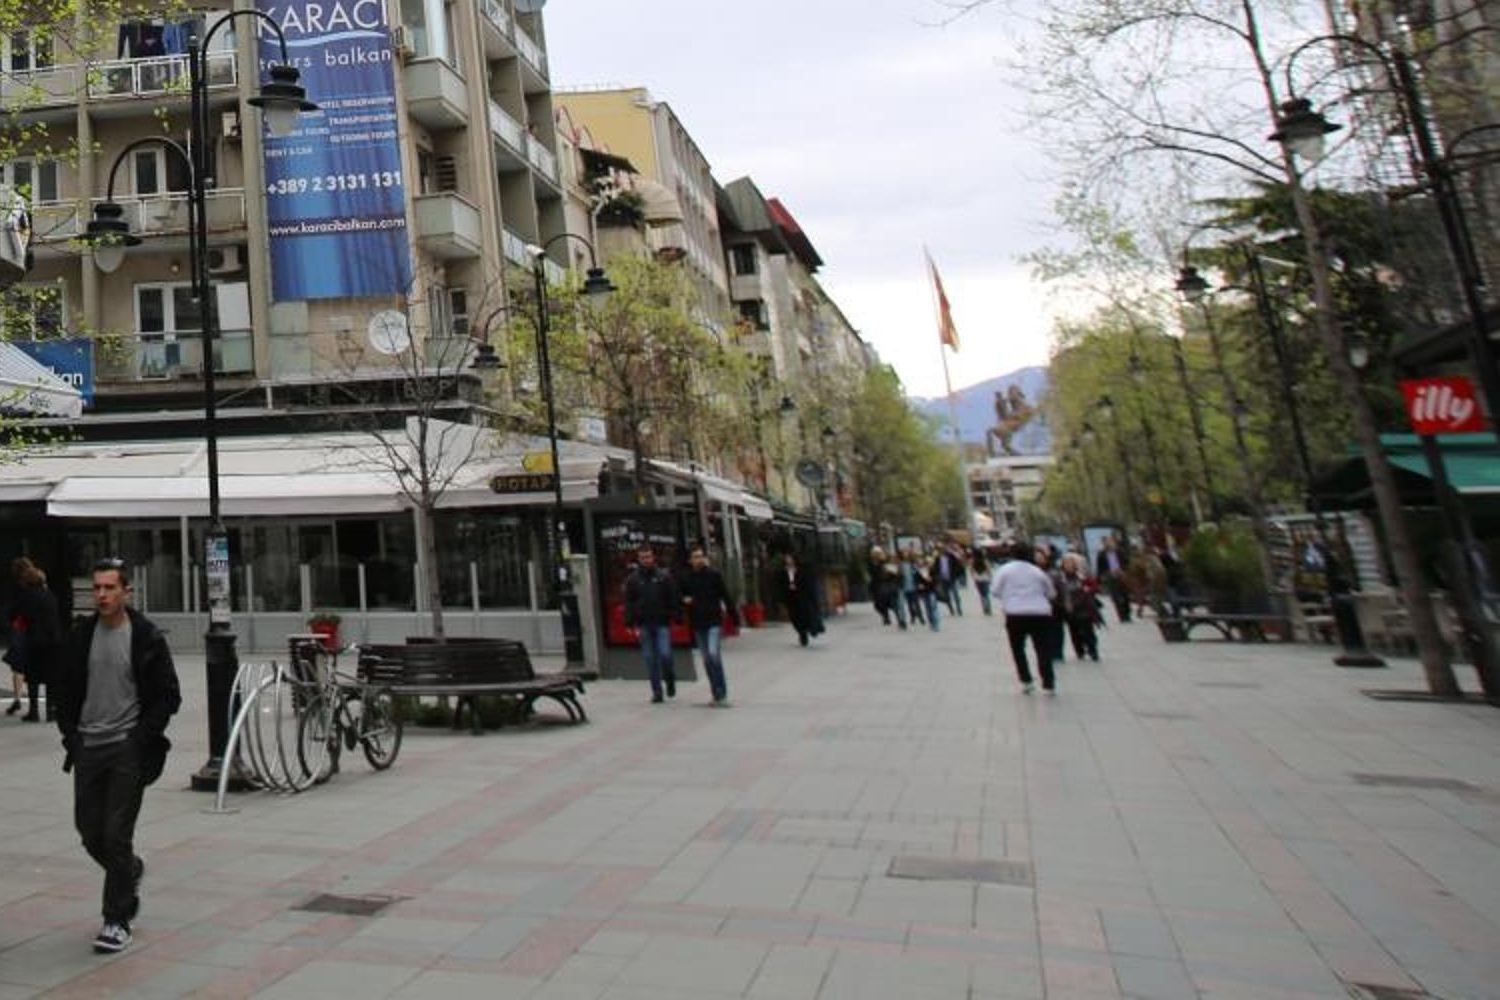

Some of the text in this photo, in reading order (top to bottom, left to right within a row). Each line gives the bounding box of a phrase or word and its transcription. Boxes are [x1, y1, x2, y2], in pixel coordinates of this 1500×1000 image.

[324, 46, 392, 67] balkan
[267, 170, 402, 195] +389 2 3131 131
[269, 218, 406, 236] www.karacibalkan.com
[1411, 385, 1475, 429] illy
